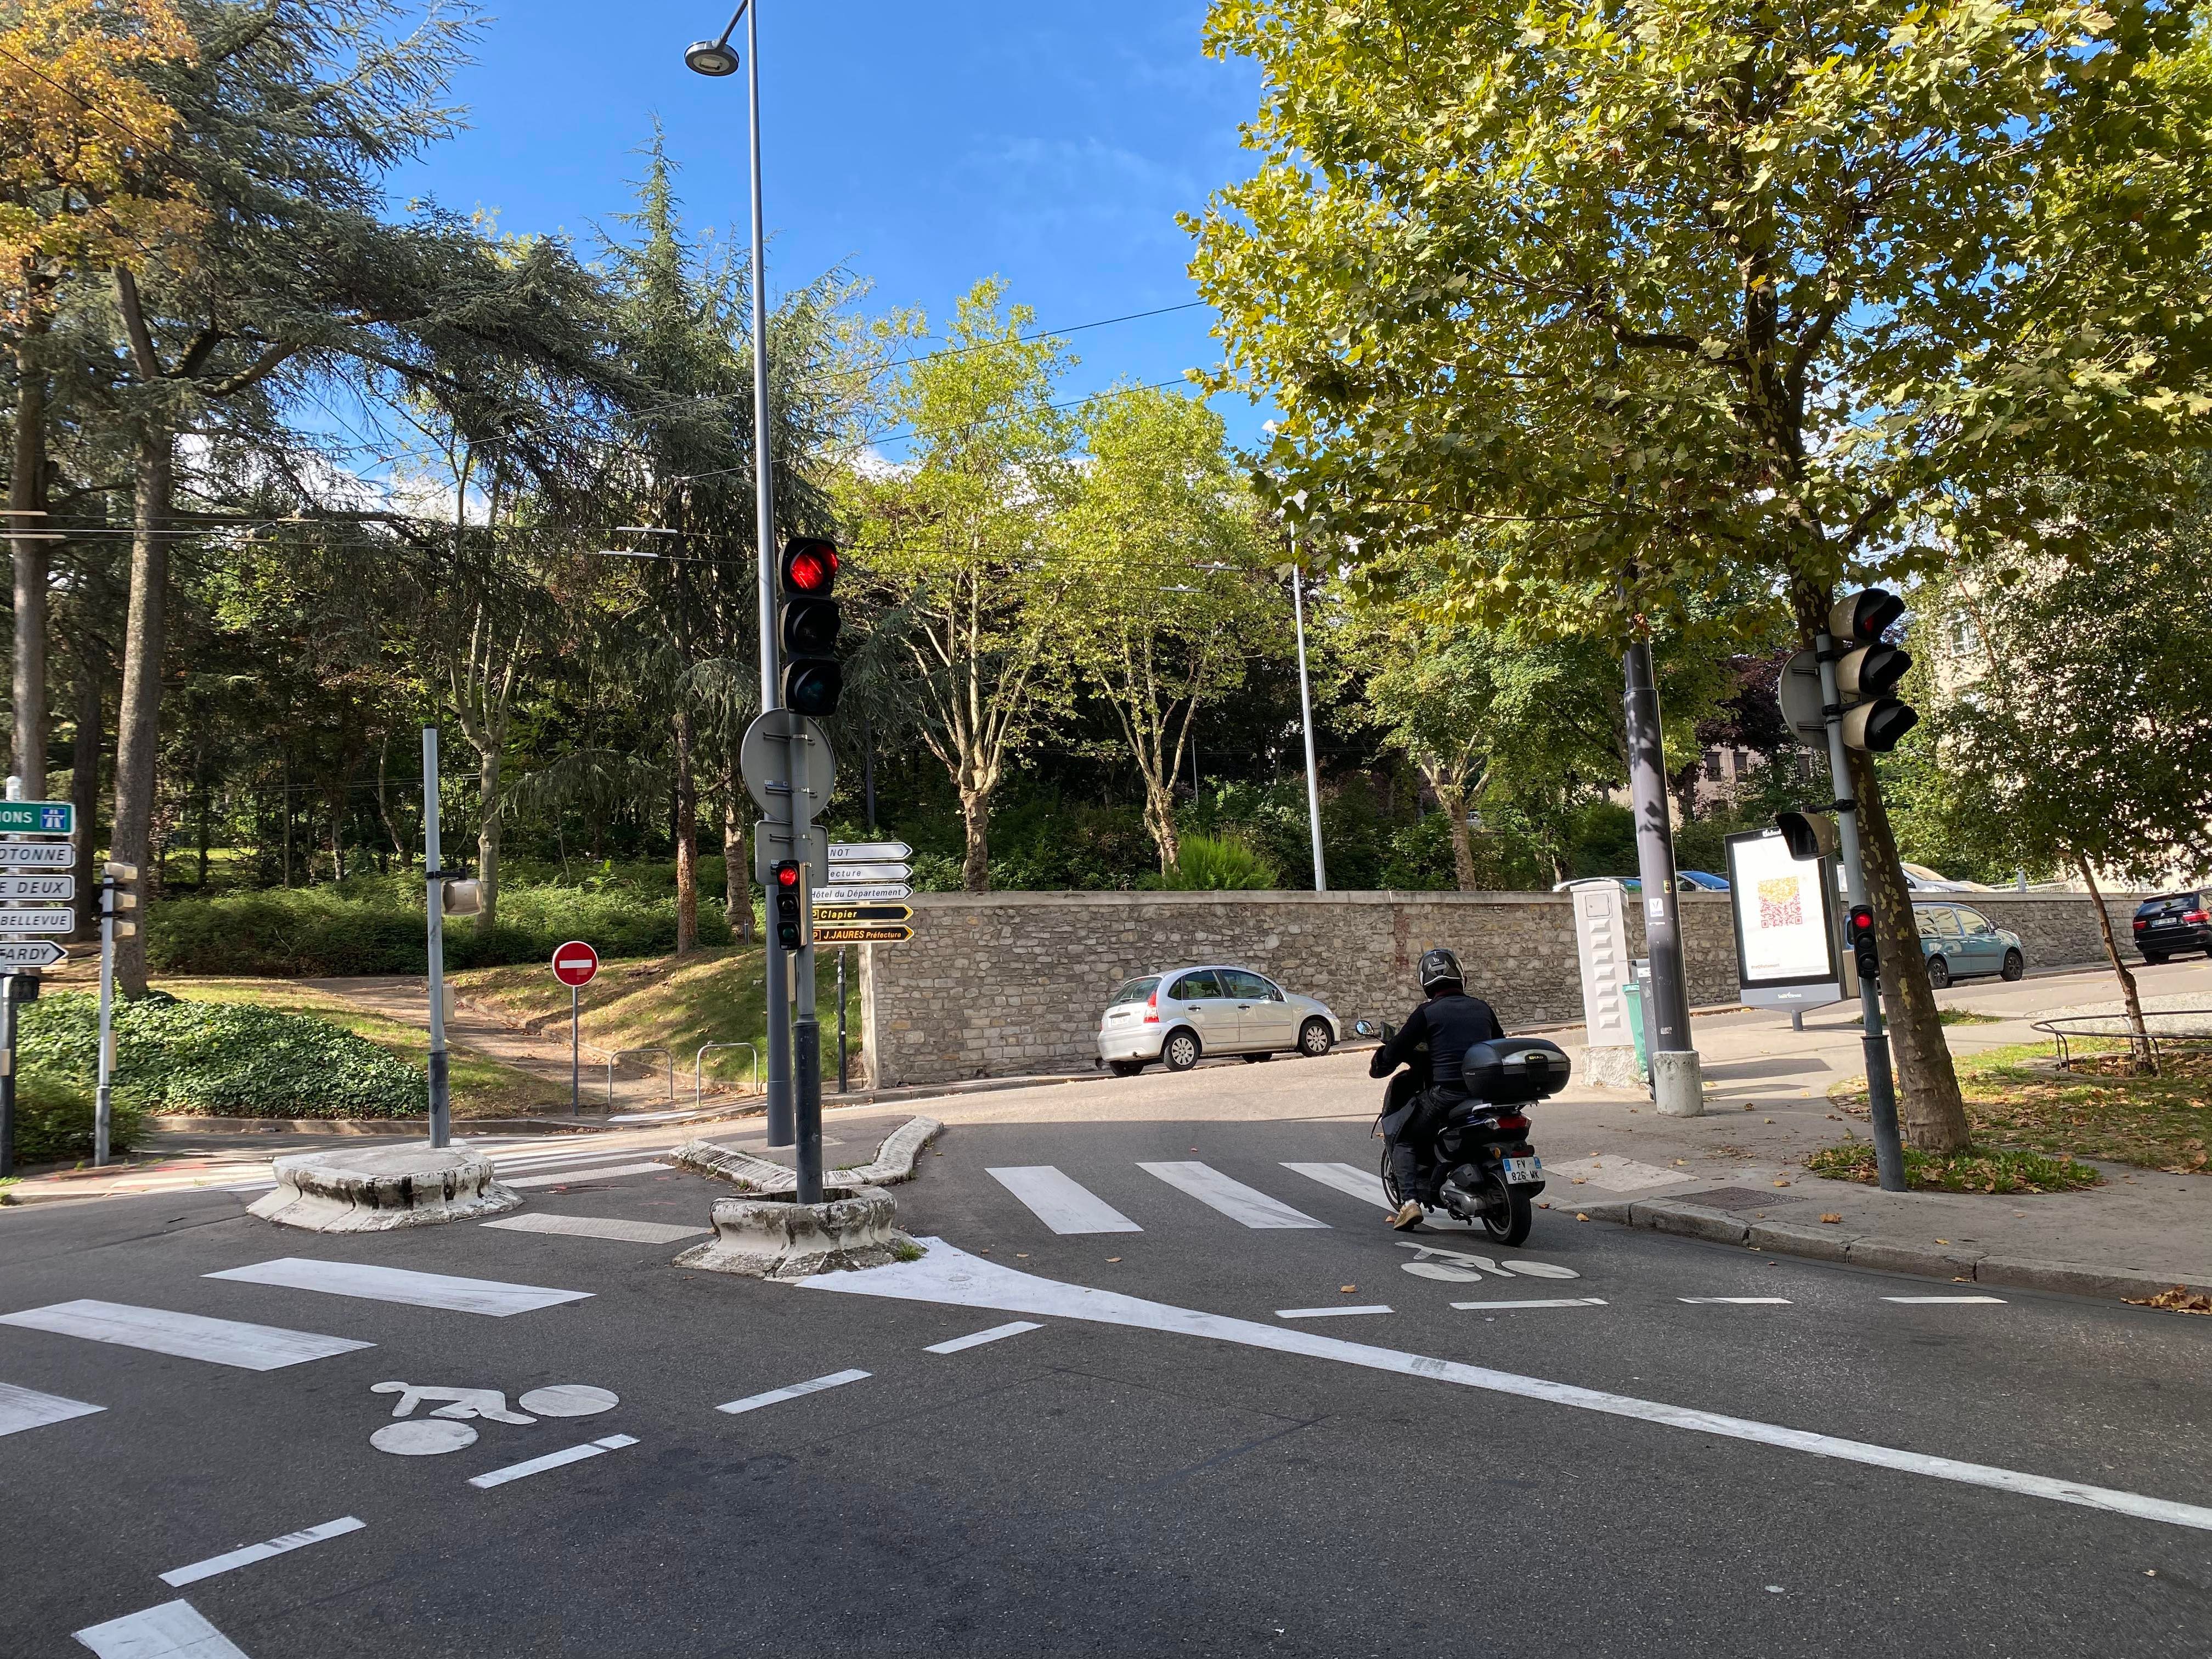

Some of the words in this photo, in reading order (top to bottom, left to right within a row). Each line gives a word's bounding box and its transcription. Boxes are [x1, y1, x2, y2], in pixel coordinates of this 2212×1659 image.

[0, 849, 66, 860] OTONNE
[17, 882, 64, 894] DEUX
[812, 890, 832, 899] Hôtel
[847, 889, 901, 899] Département
[821, 910, 857, 919] Clapier
[1, 916, 67, 926] BELLEVUE
